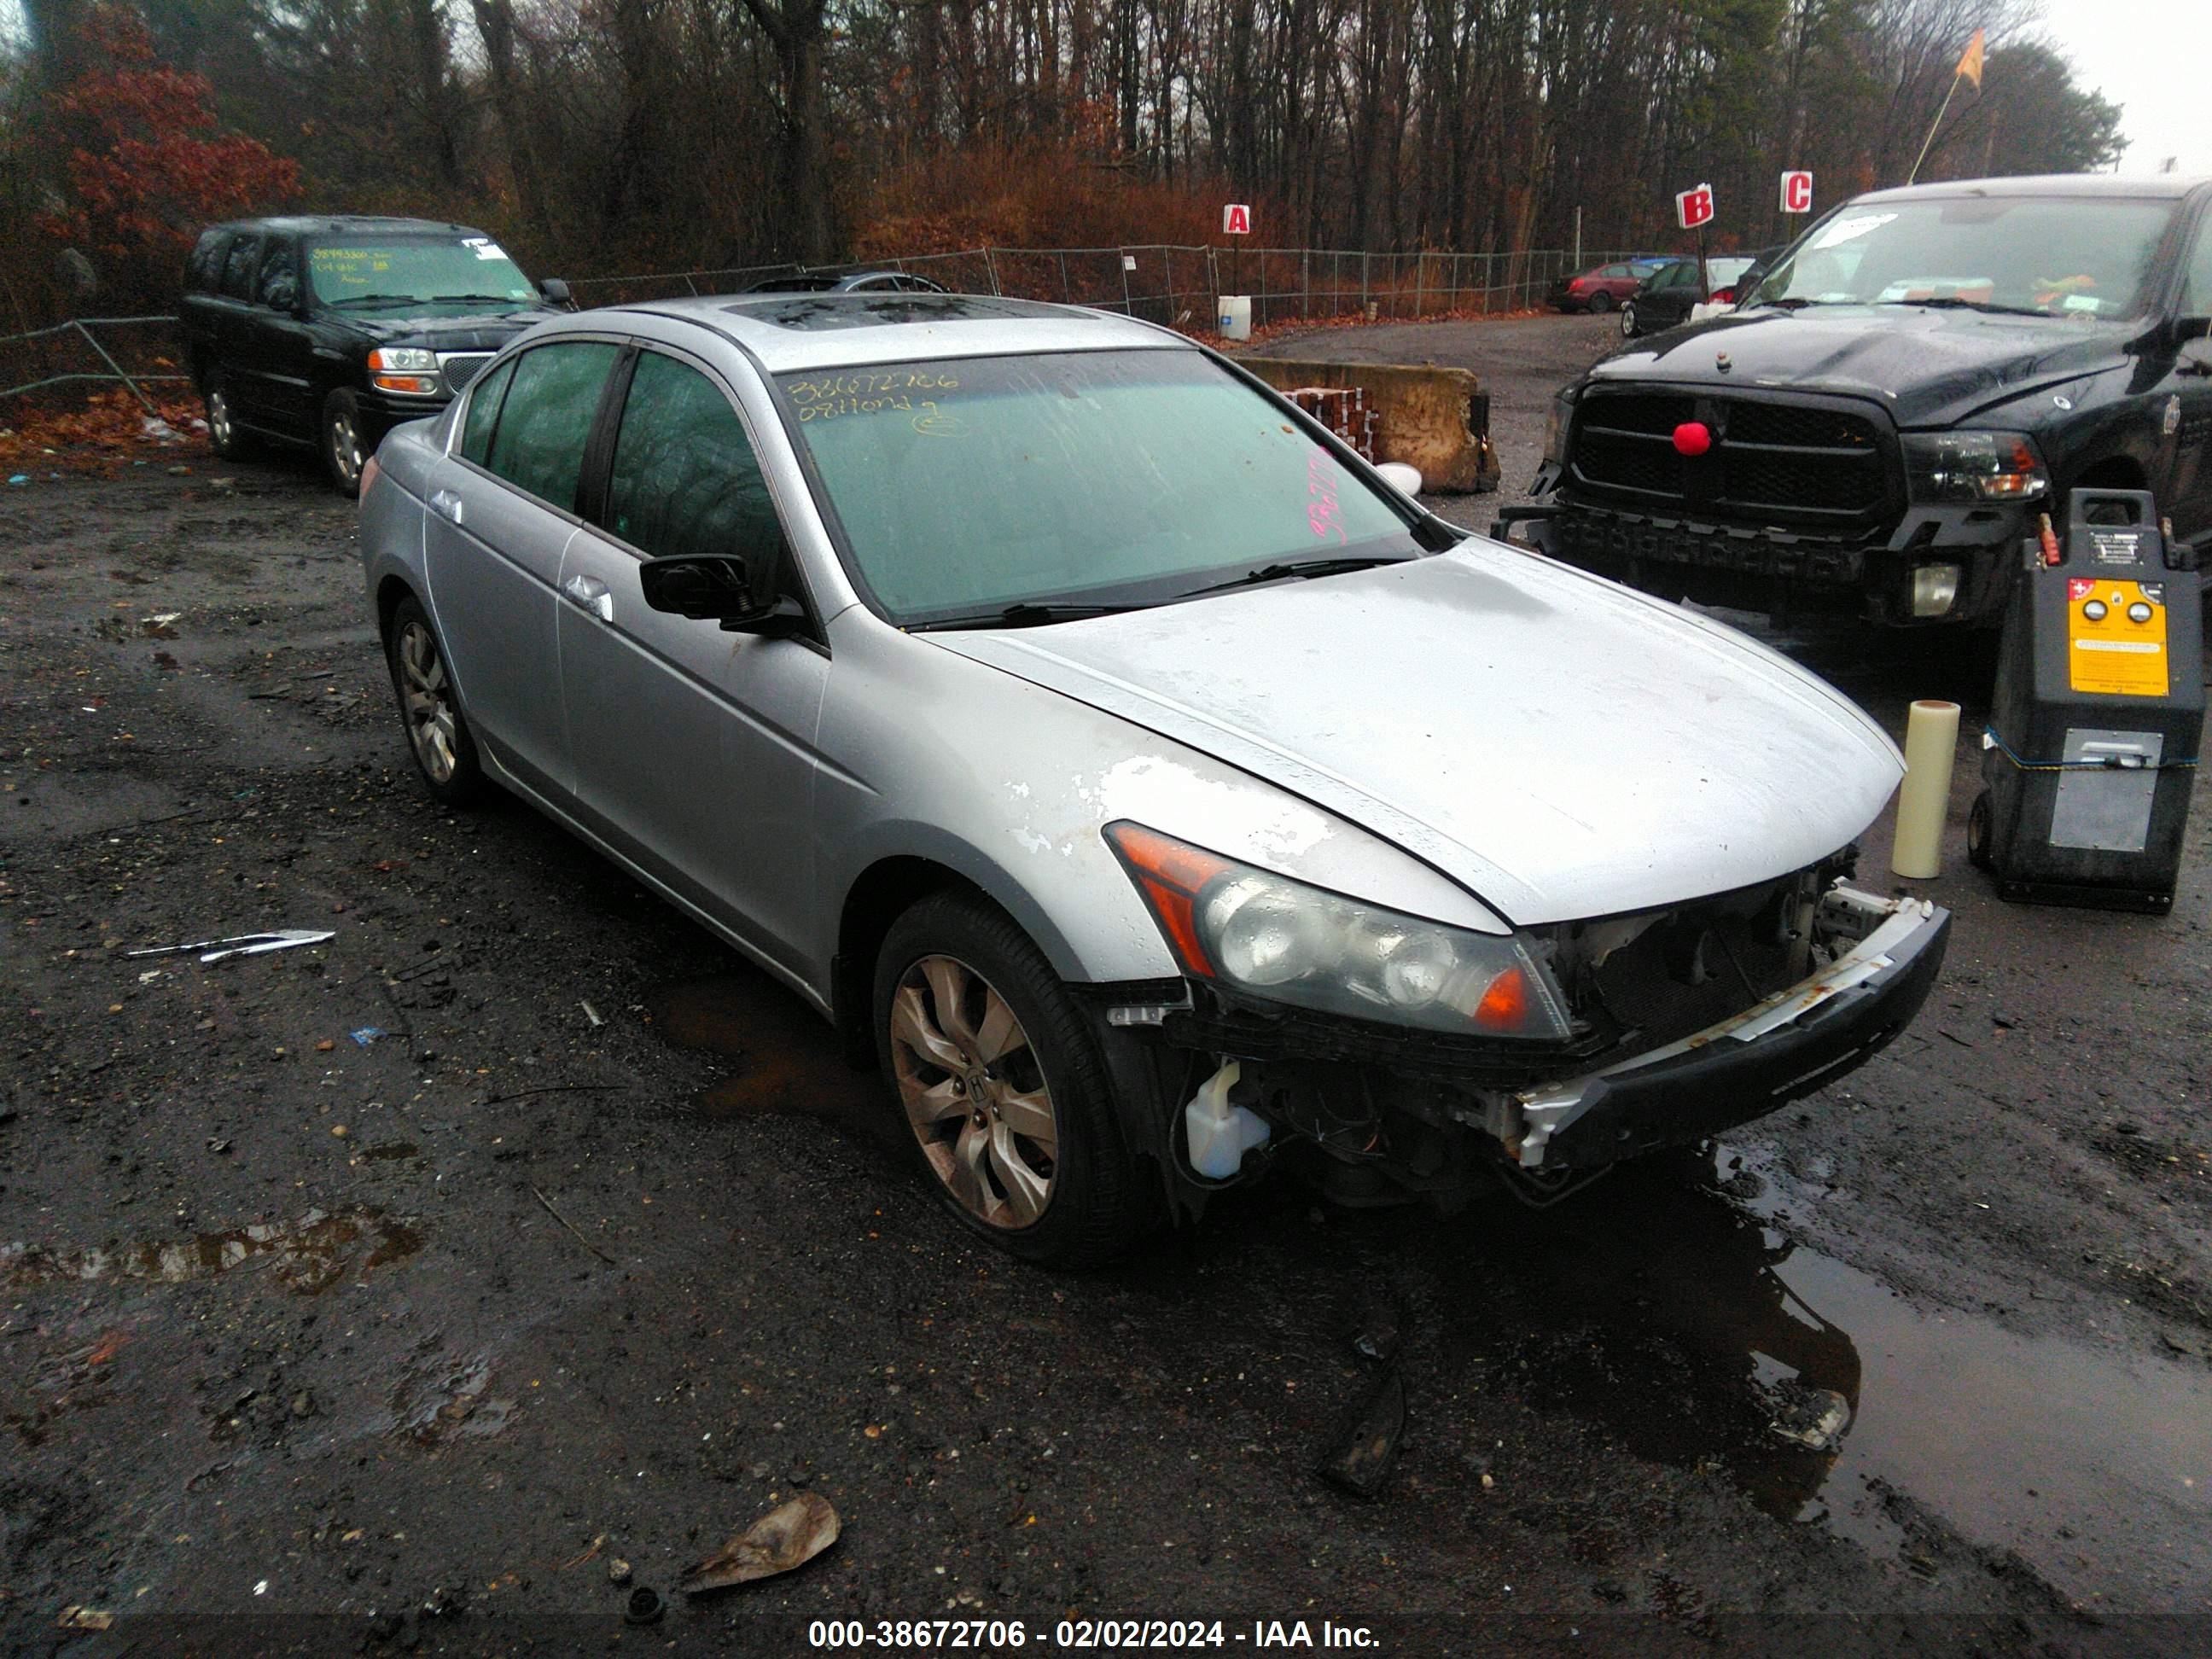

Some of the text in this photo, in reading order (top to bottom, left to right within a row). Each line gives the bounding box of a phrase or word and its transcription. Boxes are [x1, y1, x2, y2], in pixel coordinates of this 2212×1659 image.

[1683, 189, 1712, 225] B
[1787, 173, 1810, 210] C
[1228, 207, 1248, 231] A
